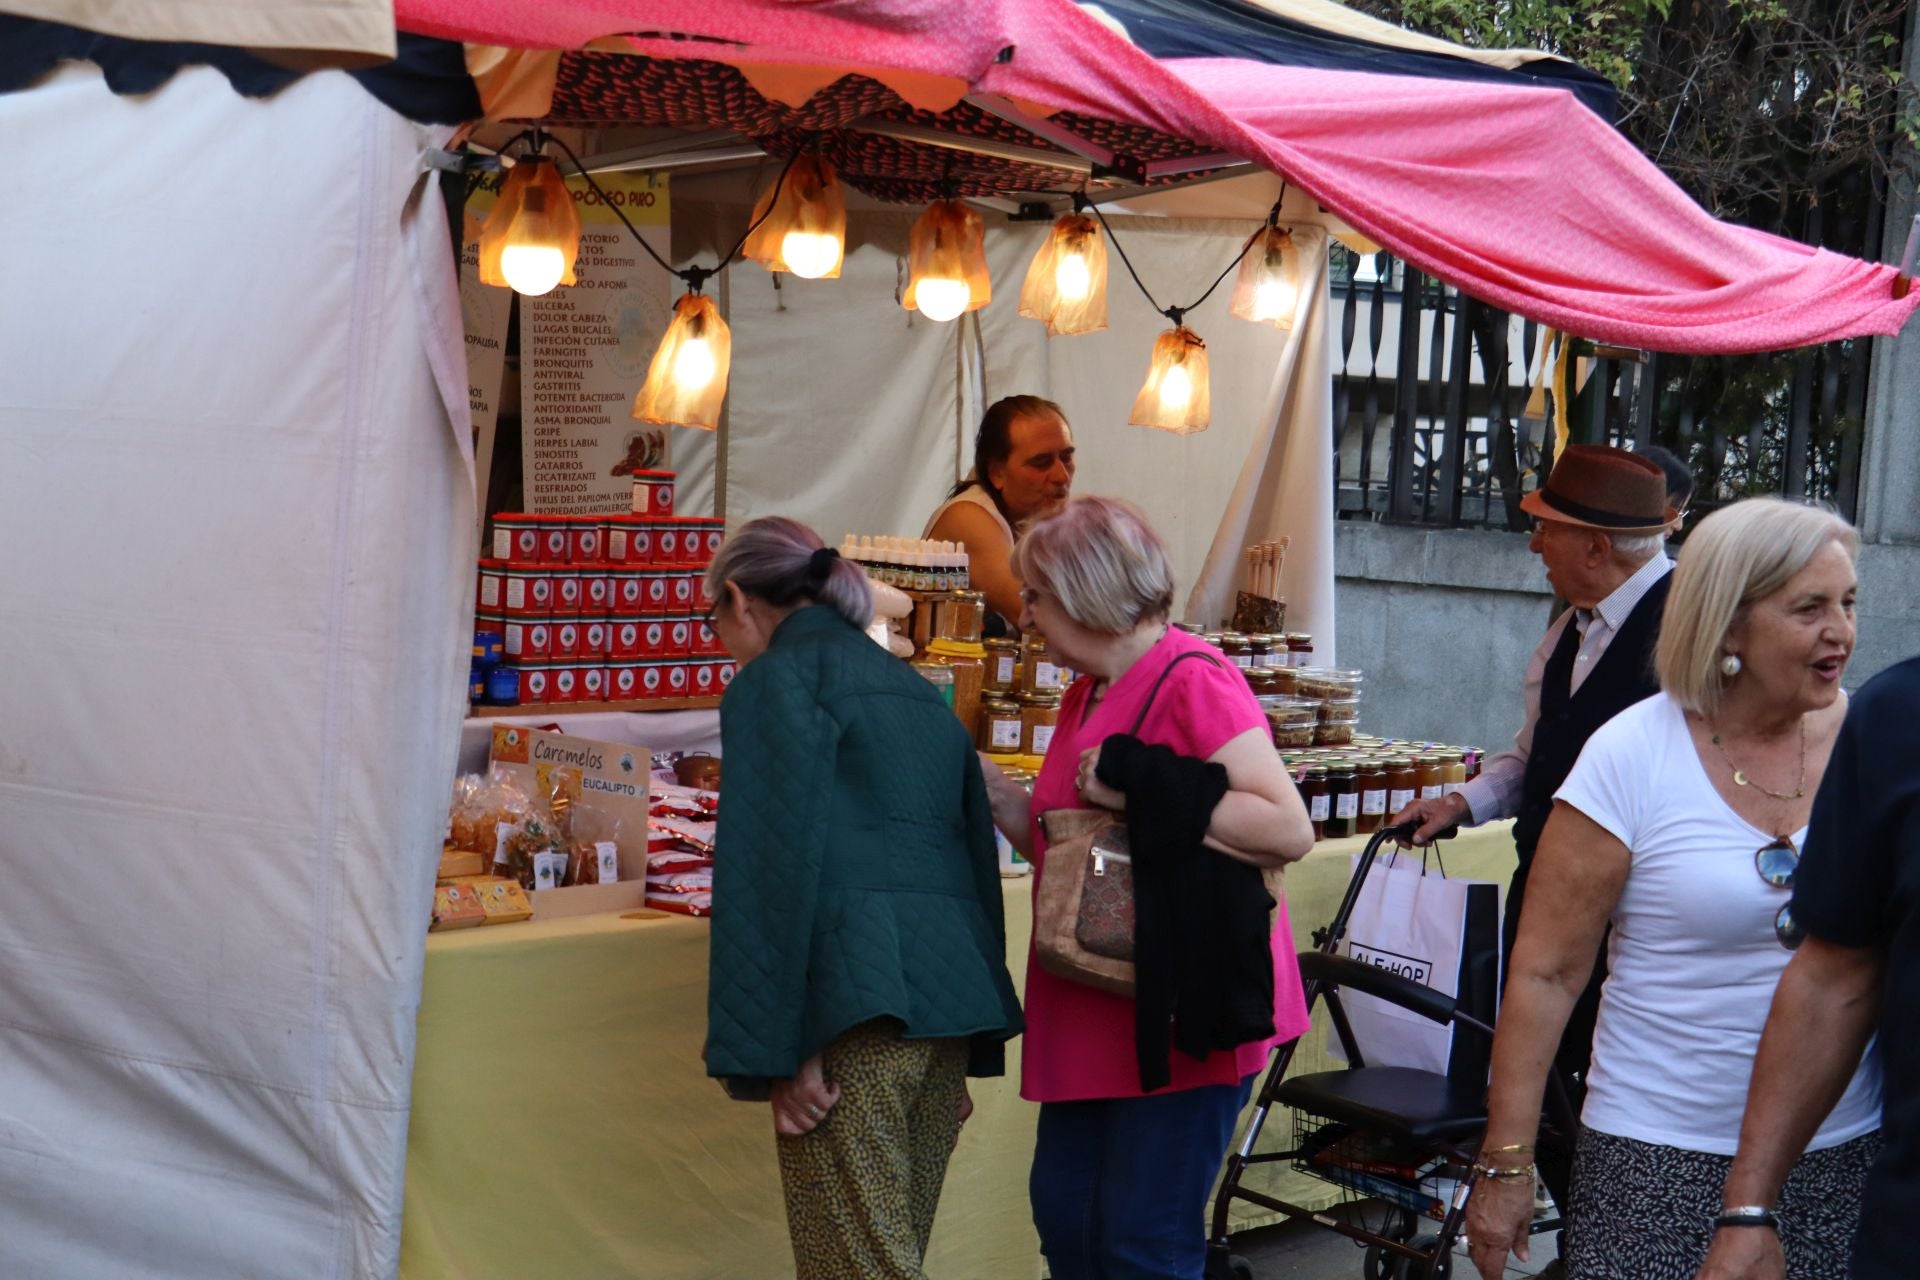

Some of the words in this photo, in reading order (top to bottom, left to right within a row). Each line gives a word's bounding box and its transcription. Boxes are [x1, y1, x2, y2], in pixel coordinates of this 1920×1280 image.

[585, 246, 604, 255] TOS
[533, 302, 576, 311] ULCERAS
[533, 313, 568, 322] DOLOR
[572, 314, 608, 323] CABEZA
[533, 325, 569, 334] LLAGAS
[572, 326, 612, 335] BUCALES
[533, 336, 581, 346] INFECIÓN
[533, 348, 587, 357] FARINGITIS
[533, 359, 594, 369] BRONQUITIS
[533, 371, 585, 380] ANTIVIRAL
[533, 382, 582, 391] GASTRITIS
[533, 394, 577, 402] POTENTE
[533, 405, 602, 414] ANTIOXIDANTE
[533, 416, 561, 425] ASMA
[564, 416, 611, 426] BRONQUIAL
[534, 427, 561, 437] GRIPE
[534, 439, 568, 448] HERPES
[571, 440, 599, 448] LABIAL
[534, 450, 579, 460] SINOSITIS
[534, 462, 583, 471] CATARROS
[534, 472, 597, 482] CICATRIZANTE
[535, 484, 588, 494] RESFRIADOS
[534, 496, 559, 505] VIRUS
[560, 495, 576, 504] DEL
[577, 494, 610, 505] PAPILOMA
[534, 506, 587, 515] PROPIEDADES
[589, 503, 633, 514] ANTIALERGIC
[583, 778, 636, 796] EUCALIPTO
